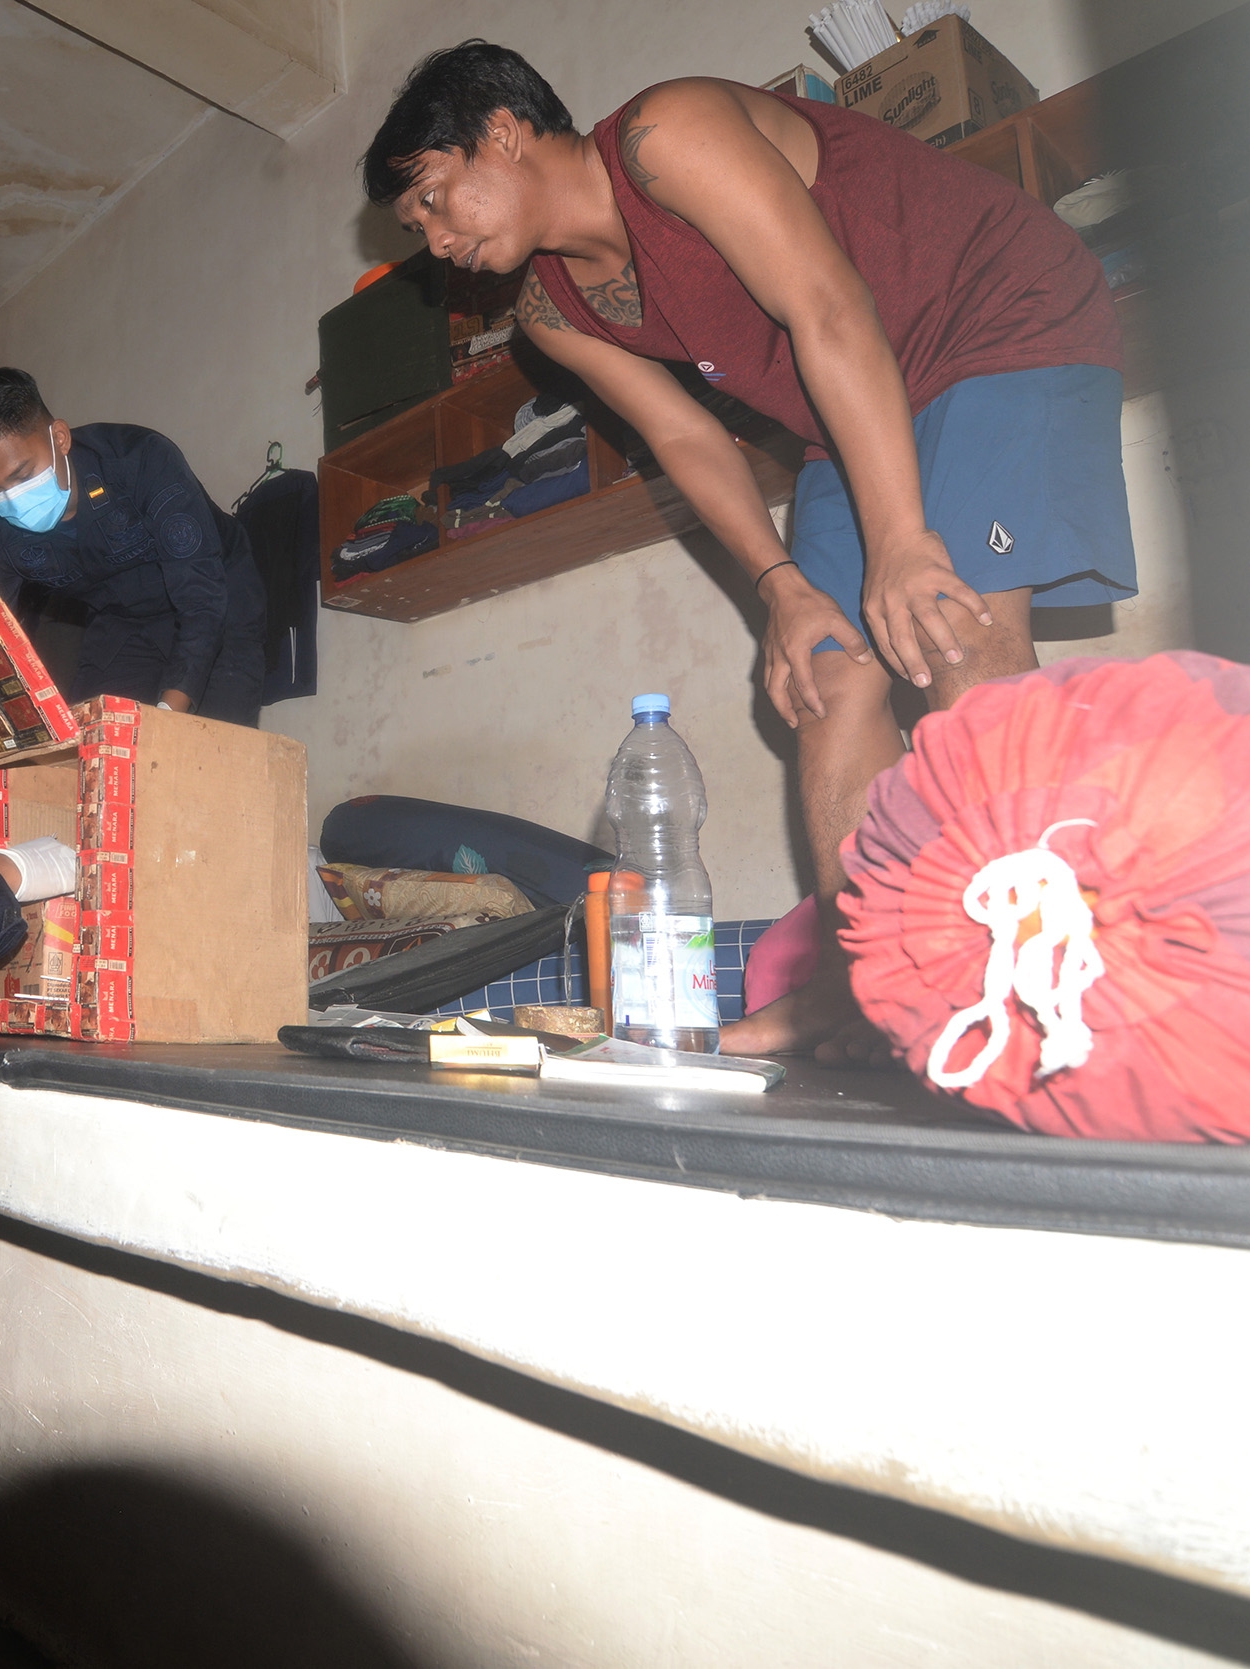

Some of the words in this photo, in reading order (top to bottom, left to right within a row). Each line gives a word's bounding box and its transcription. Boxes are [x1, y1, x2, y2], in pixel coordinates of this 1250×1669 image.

[845, 65, 873, 89] 6482
[845, 77, 883, 108] LIME
[883, 75, 936, 125] Sunlight
[25, 652, 44, 680] MENARA
[55, 704, 74, 731] MENARA
[692, 974, 718, 990] Mine
